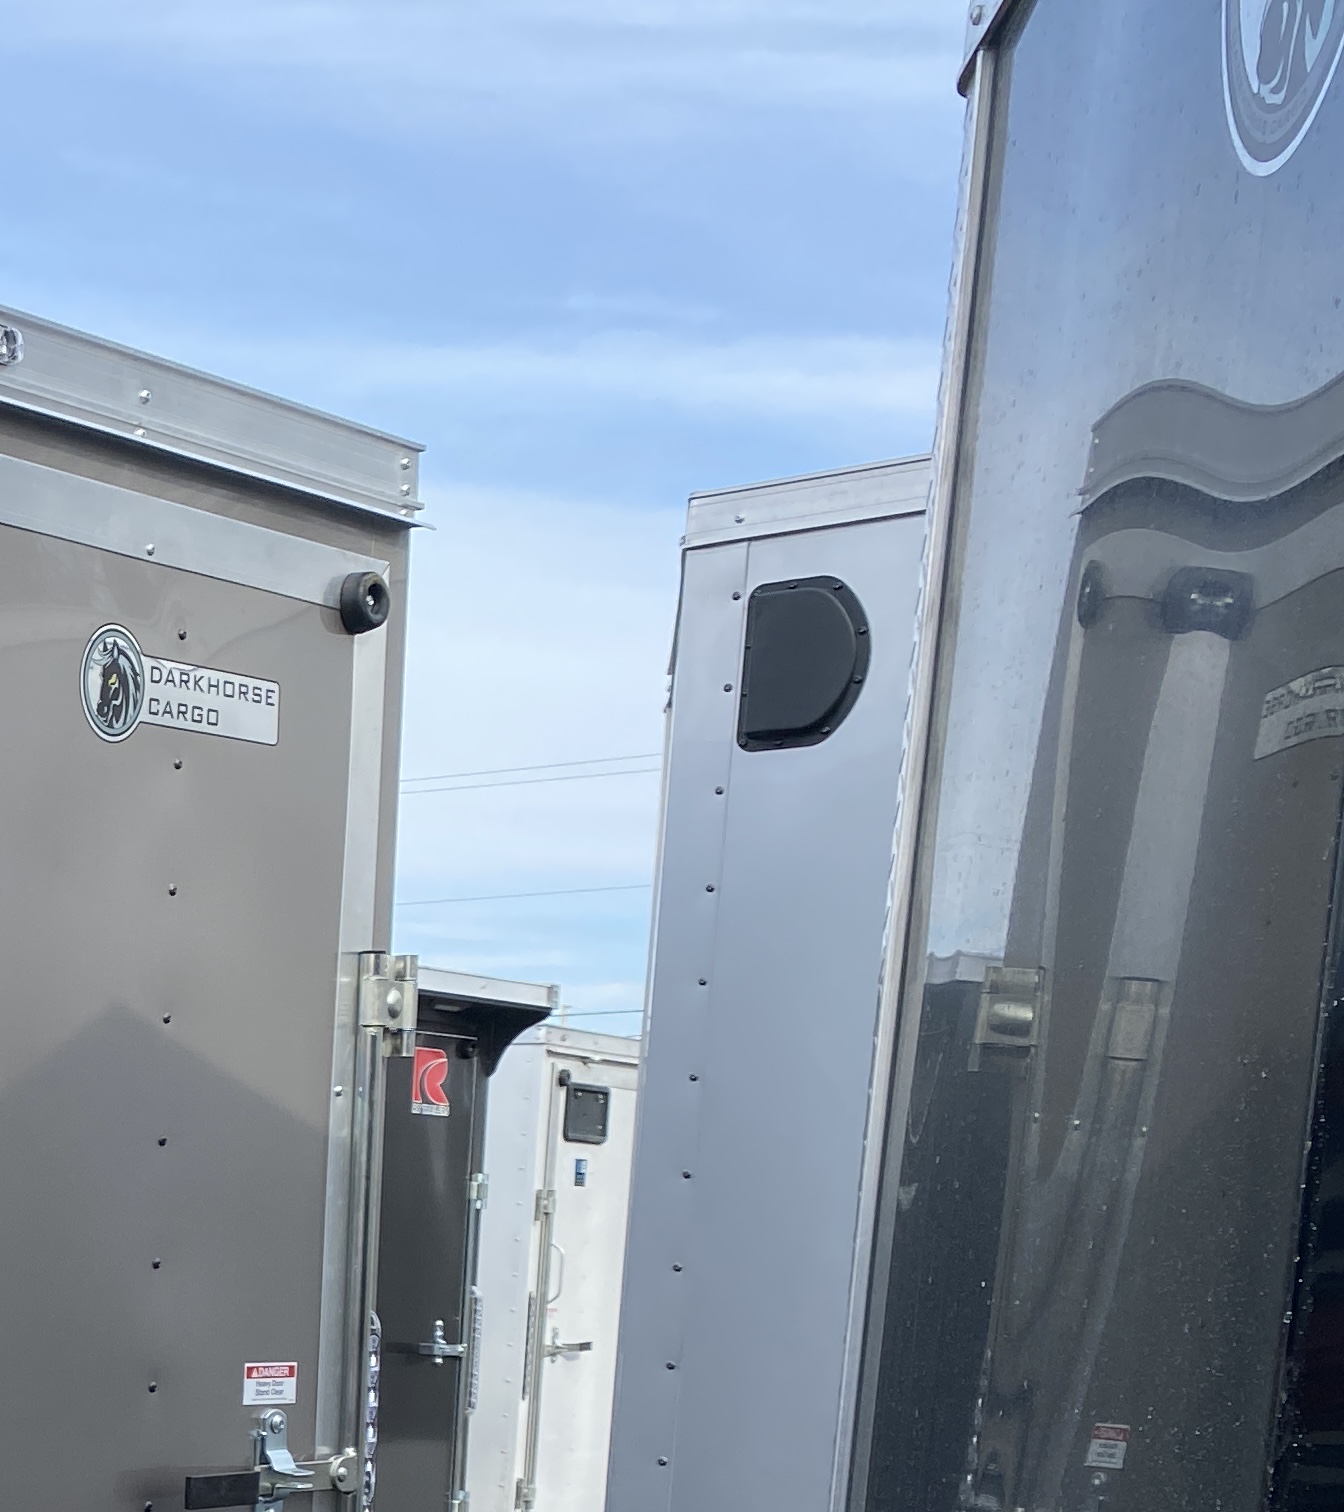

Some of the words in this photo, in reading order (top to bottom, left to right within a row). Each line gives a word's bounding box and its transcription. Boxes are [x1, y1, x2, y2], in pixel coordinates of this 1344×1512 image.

[150, 665, 276, 707] DARKHORSE
[148, 697, 220, 727] CARGO
[258, 1366, 290, 1378] DANGER
